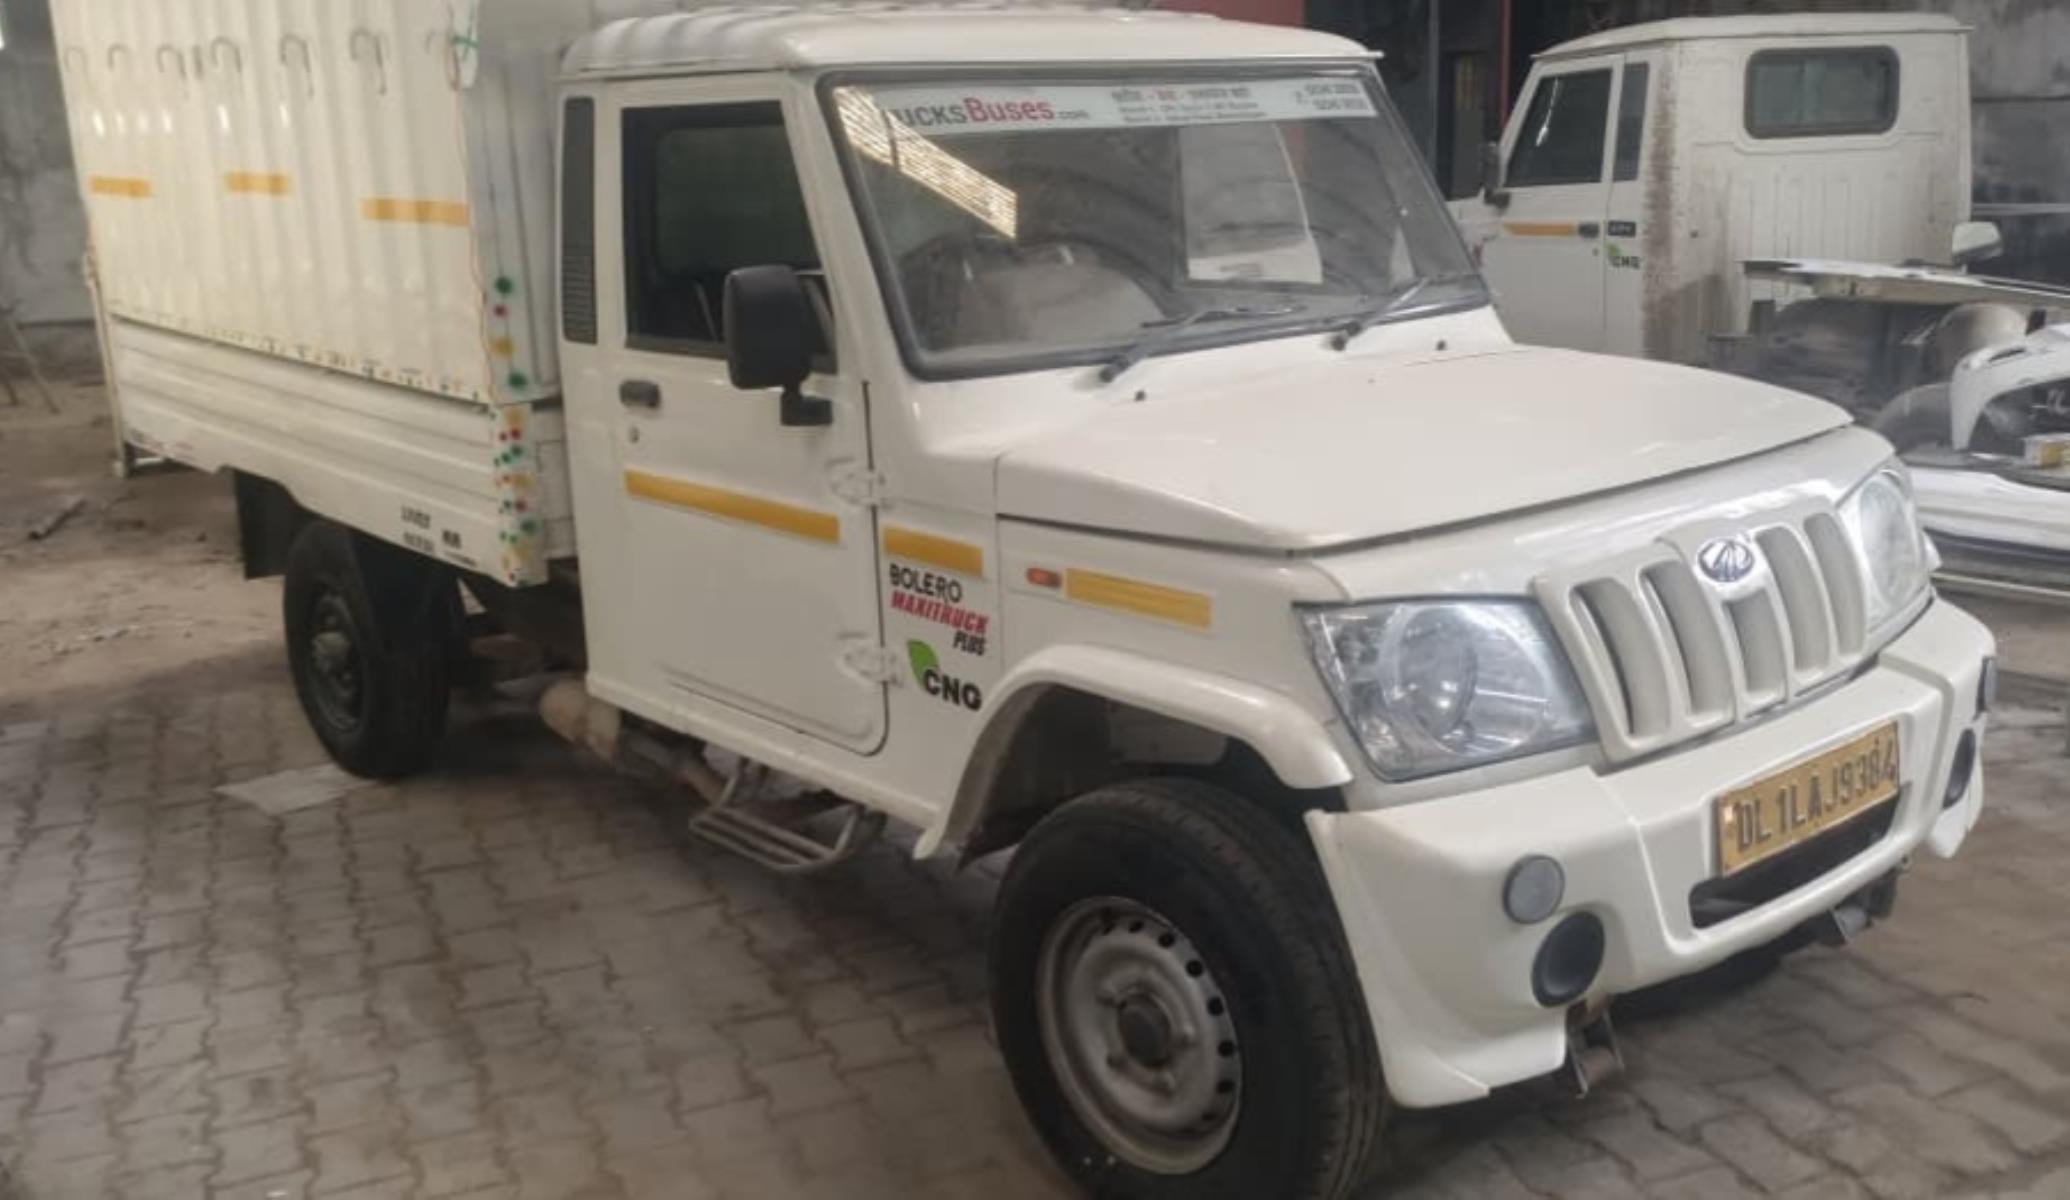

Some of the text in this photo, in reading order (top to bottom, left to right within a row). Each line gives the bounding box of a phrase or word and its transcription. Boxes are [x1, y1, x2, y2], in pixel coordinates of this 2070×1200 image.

[889, 562, 963, 603] BOLERO
[890, 589, 990, 634] MAXITRUCK
[953, 630, 986, 656] PLUS
[923, 668, 983, 711] CNG
